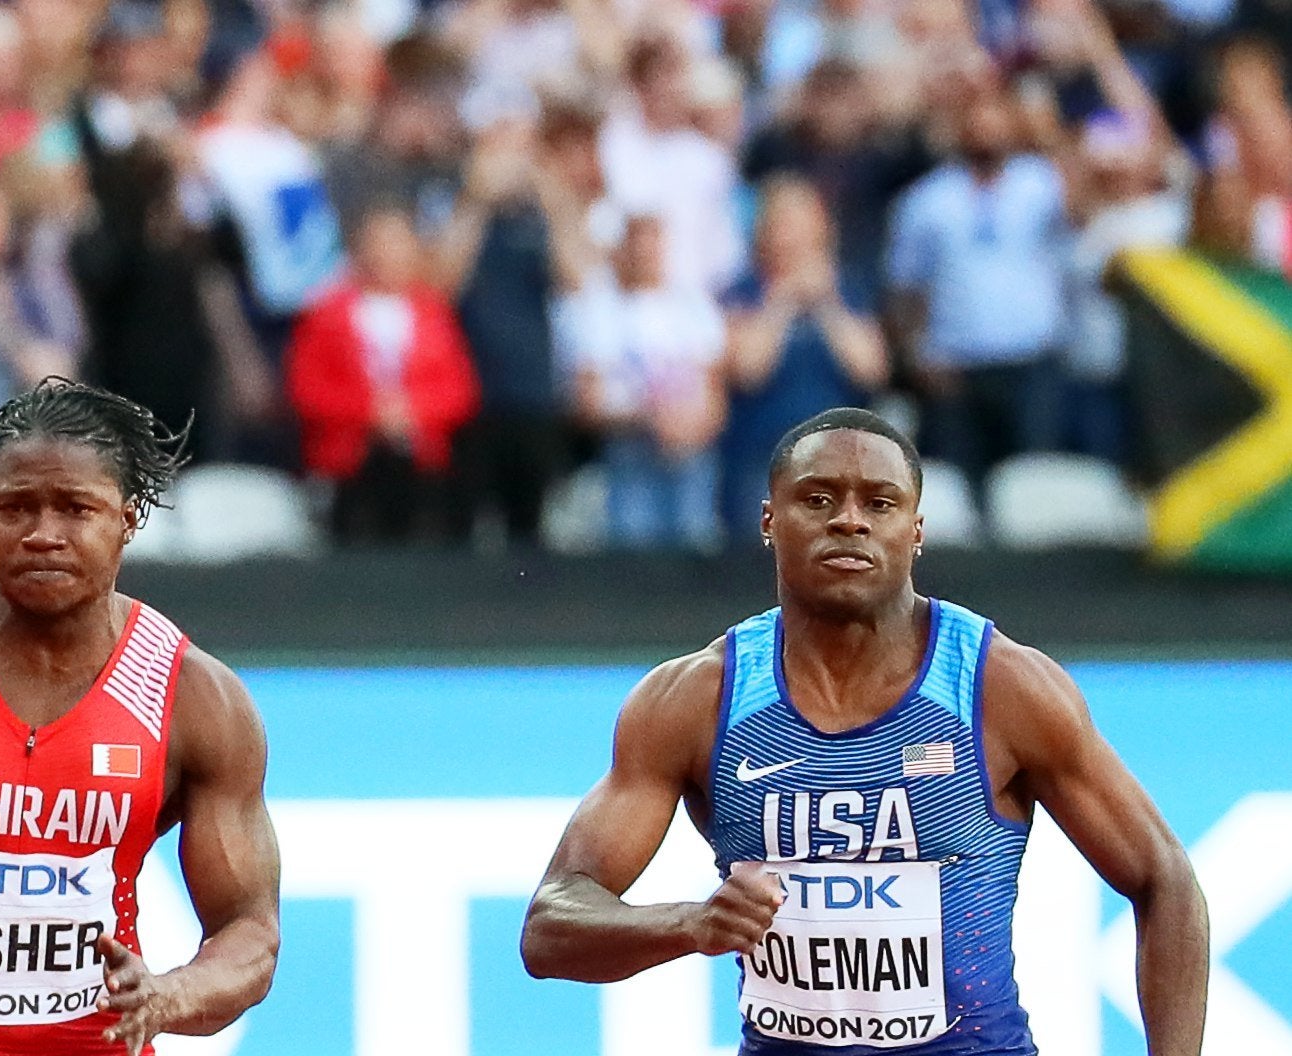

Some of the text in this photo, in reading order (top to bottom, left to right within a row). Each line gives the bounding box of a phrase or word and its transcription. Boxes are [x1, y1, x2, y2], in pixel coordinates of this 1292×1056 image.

[763, 787, 920, 863] USA
[788, 873, 903, 909] TDK
[748, 931, 930, 993] COLEMAN
[47, 983, 104, 1015] 2017
[746, 1003, 936, 1042] LONDON 2017
